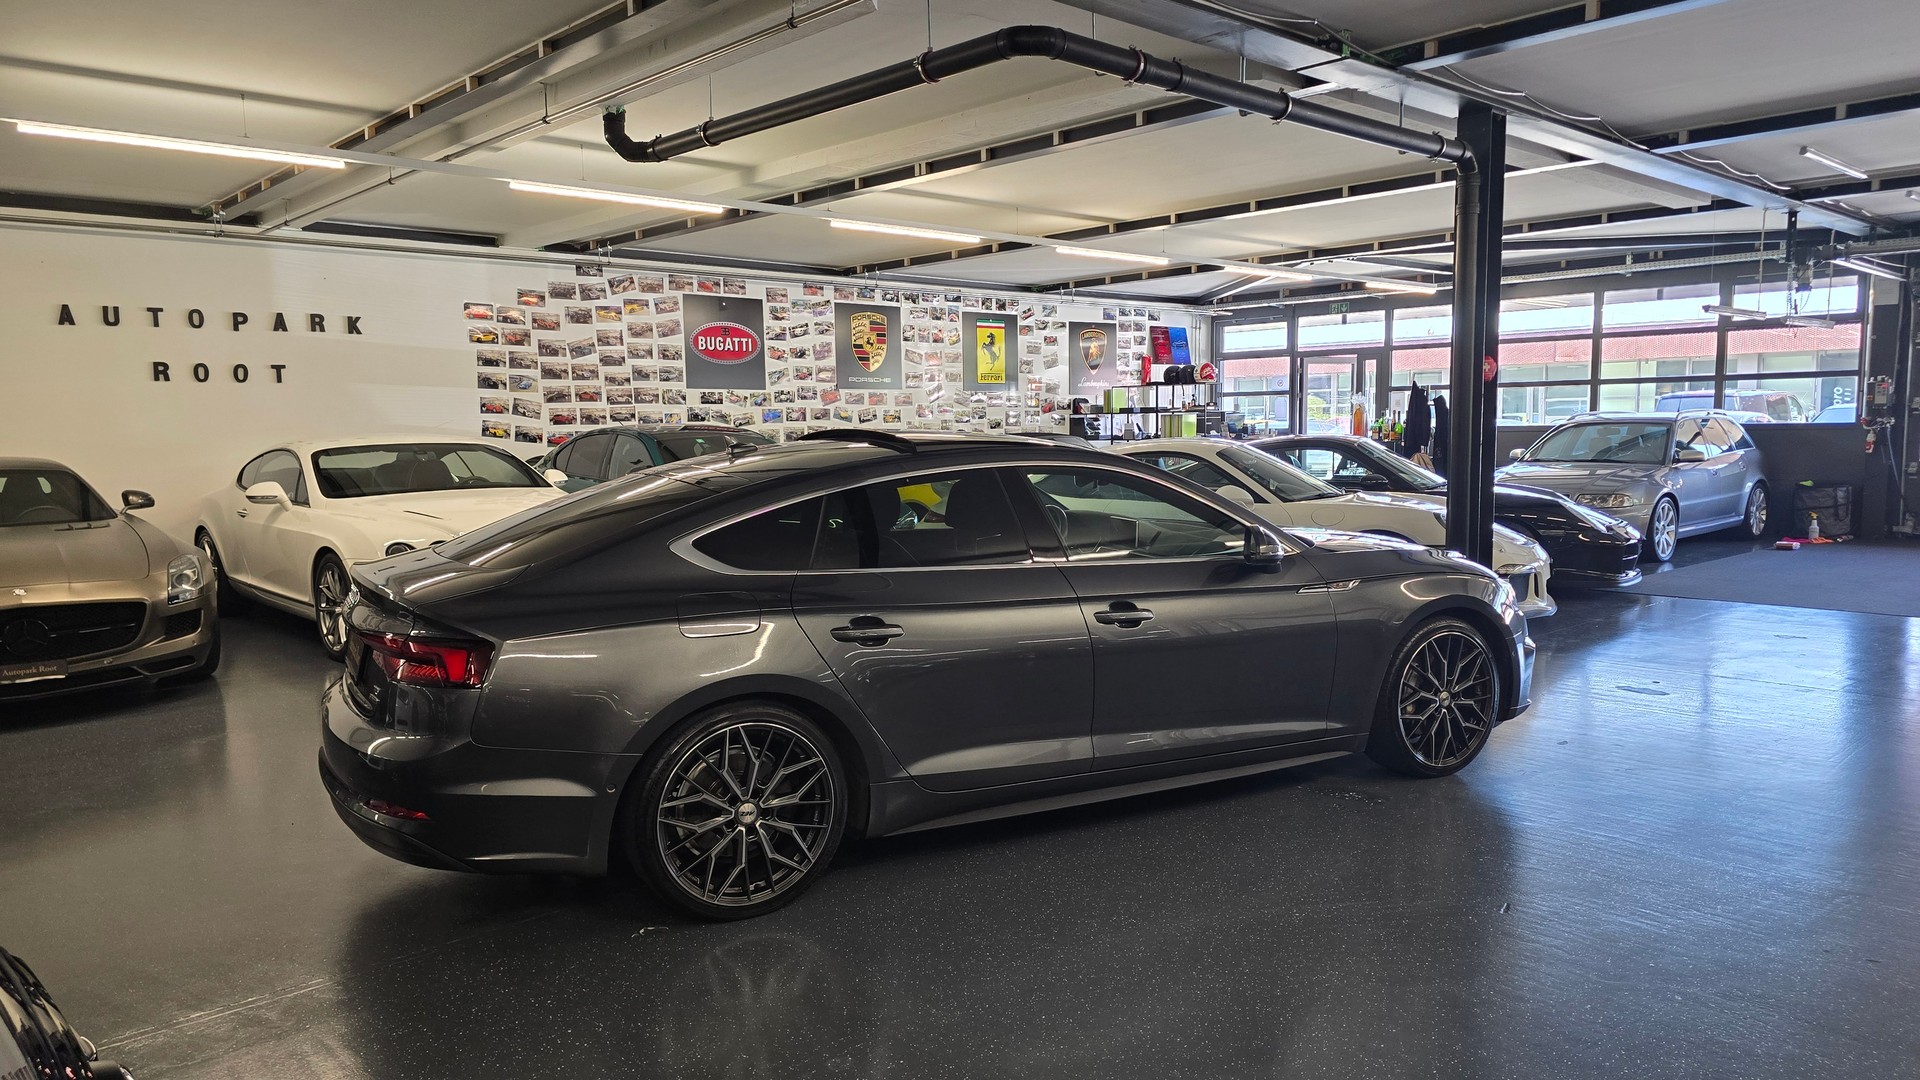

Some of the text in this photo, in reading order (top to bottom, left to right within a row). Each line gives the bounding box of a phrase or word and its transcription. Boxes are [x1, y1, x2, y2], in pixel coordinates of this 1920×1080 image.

[58, 304, 362, 335] AUTOPARK
[698, 336, 752, 352] BUGATTI
[152, 361, 286, 383] ROOT
[980, 372, 1003, 381] Ferrari
[2, 666, 38, 677] Autopark
